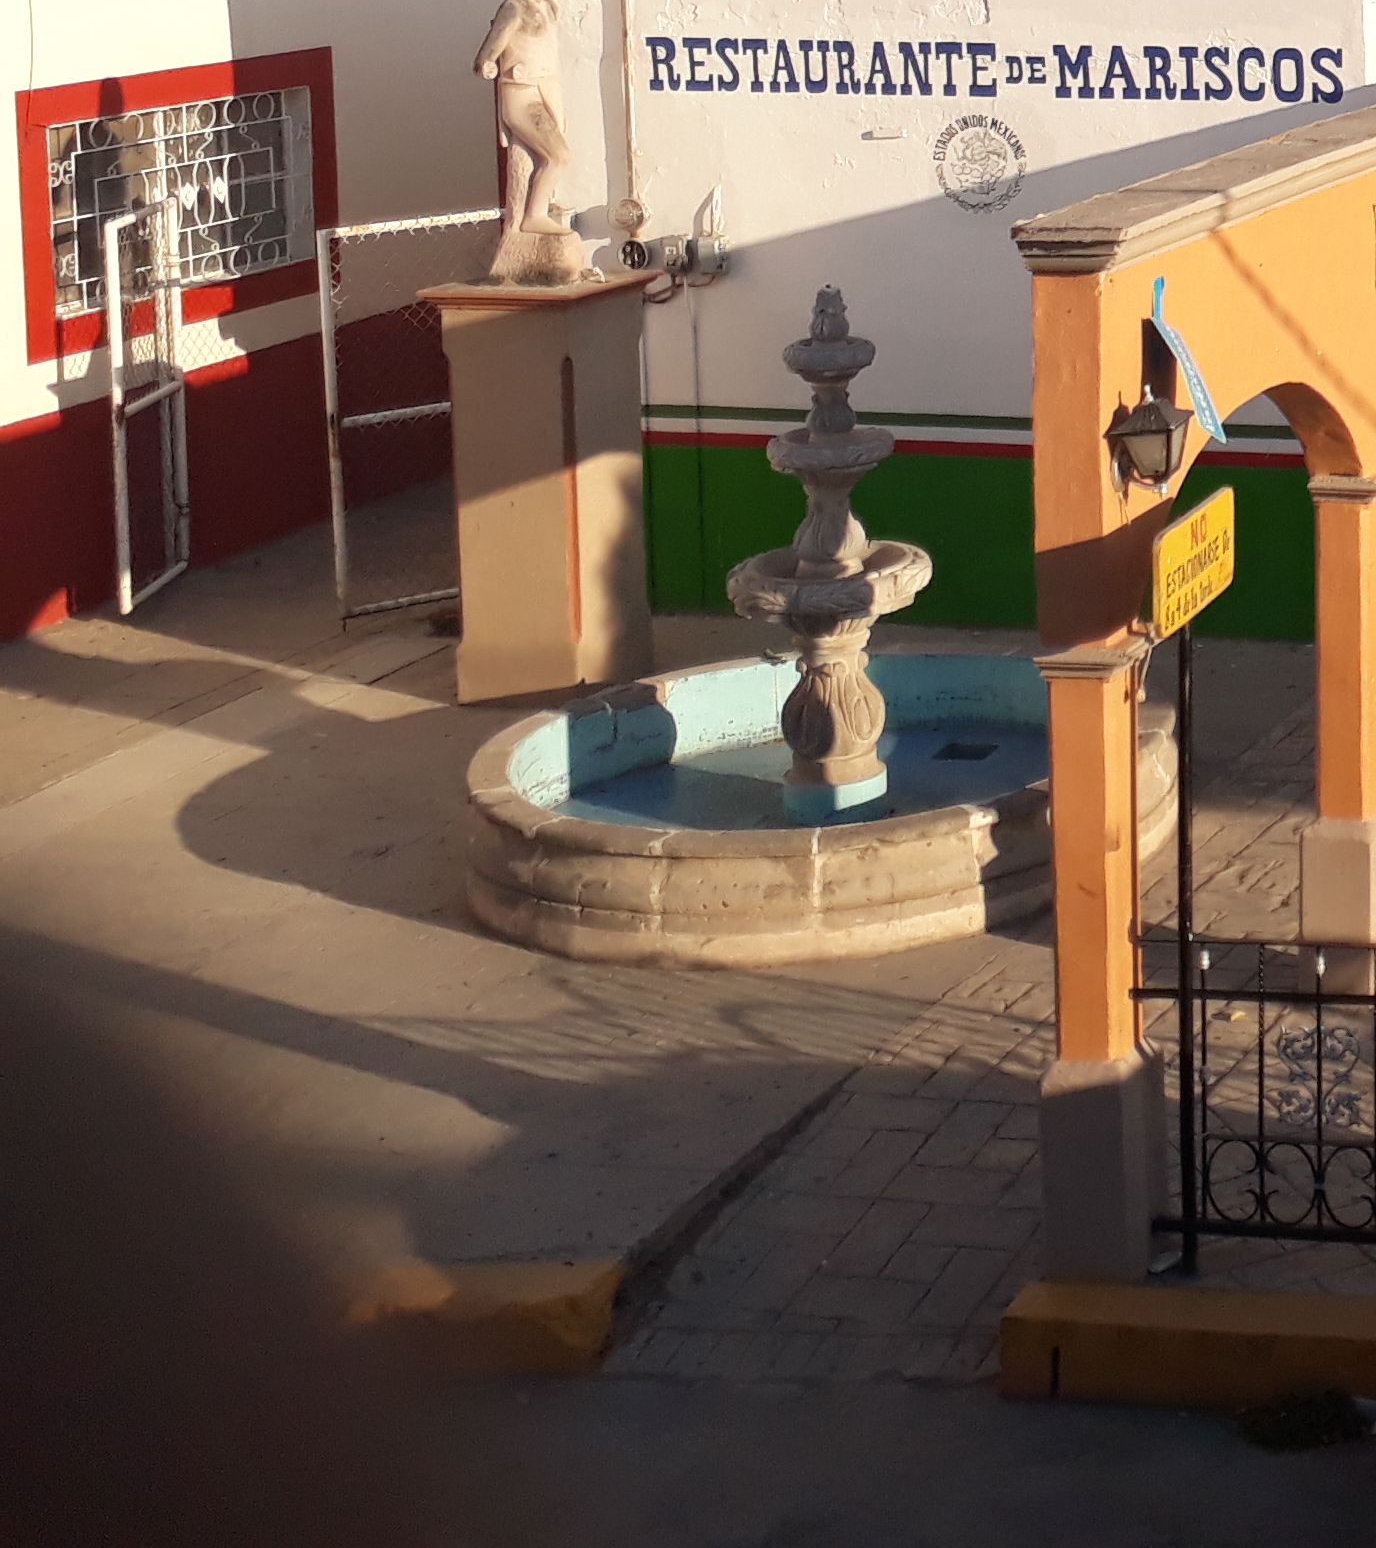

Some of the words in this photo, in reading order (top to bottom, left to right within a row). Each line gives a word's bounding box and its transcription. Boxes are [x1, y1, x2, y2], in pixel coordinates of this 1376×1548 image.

[646, 36, 998, 97] RESTAURANTE
[1005, 53, 1047, 85] DE
[1053, 44, 1345, 104] MARISCOS
[933, 123, 959, 162] ESTADOS
[955, 114, 989, 132] UNIDOS
[1190, 512, 1207, 550] NO
